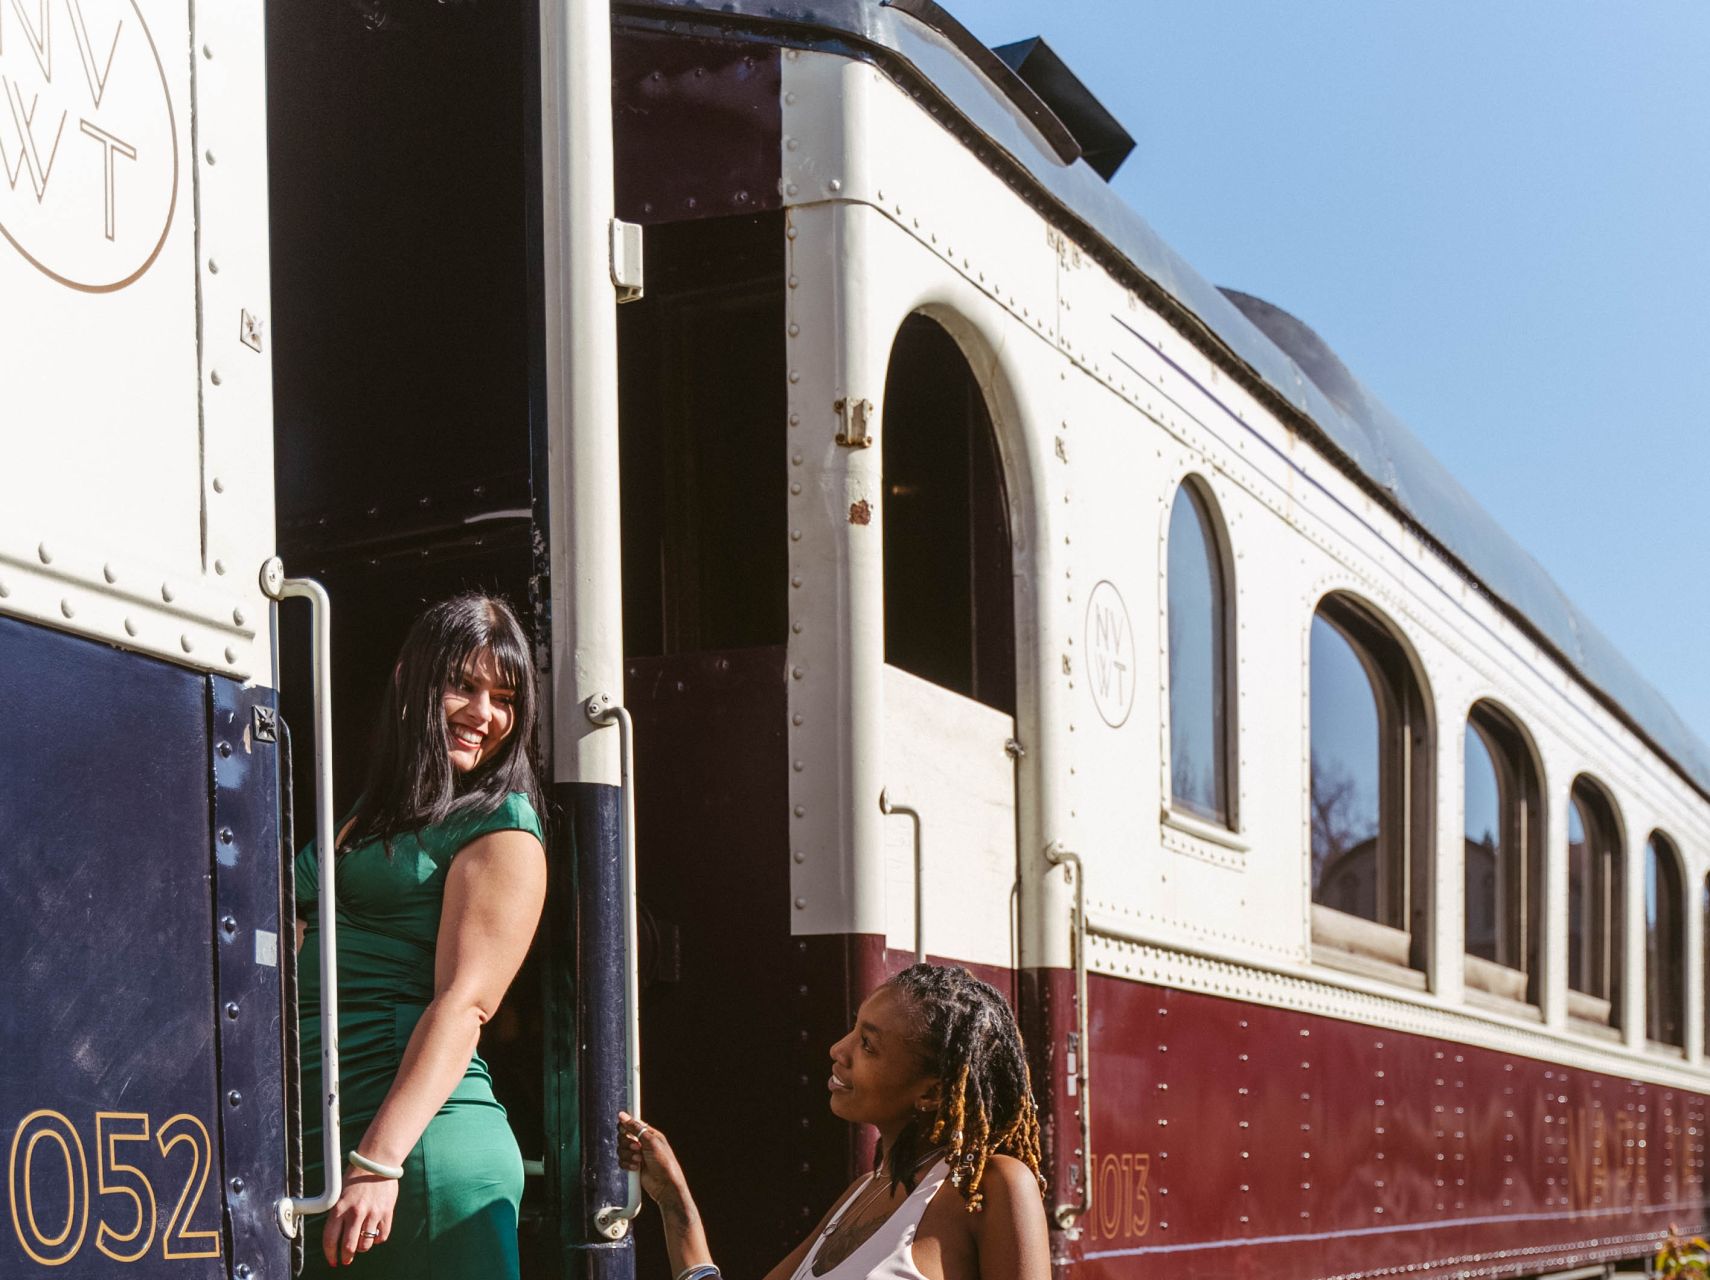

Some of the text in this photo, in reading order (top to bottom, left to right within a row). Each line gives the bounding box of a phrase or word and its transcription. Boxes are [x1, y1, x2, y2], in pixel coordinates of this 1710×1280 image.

[1096, 603, 1124, 655] NV
[1095, 652, 1127, 706] WT
[9, 1109, 220, 1266] 052
